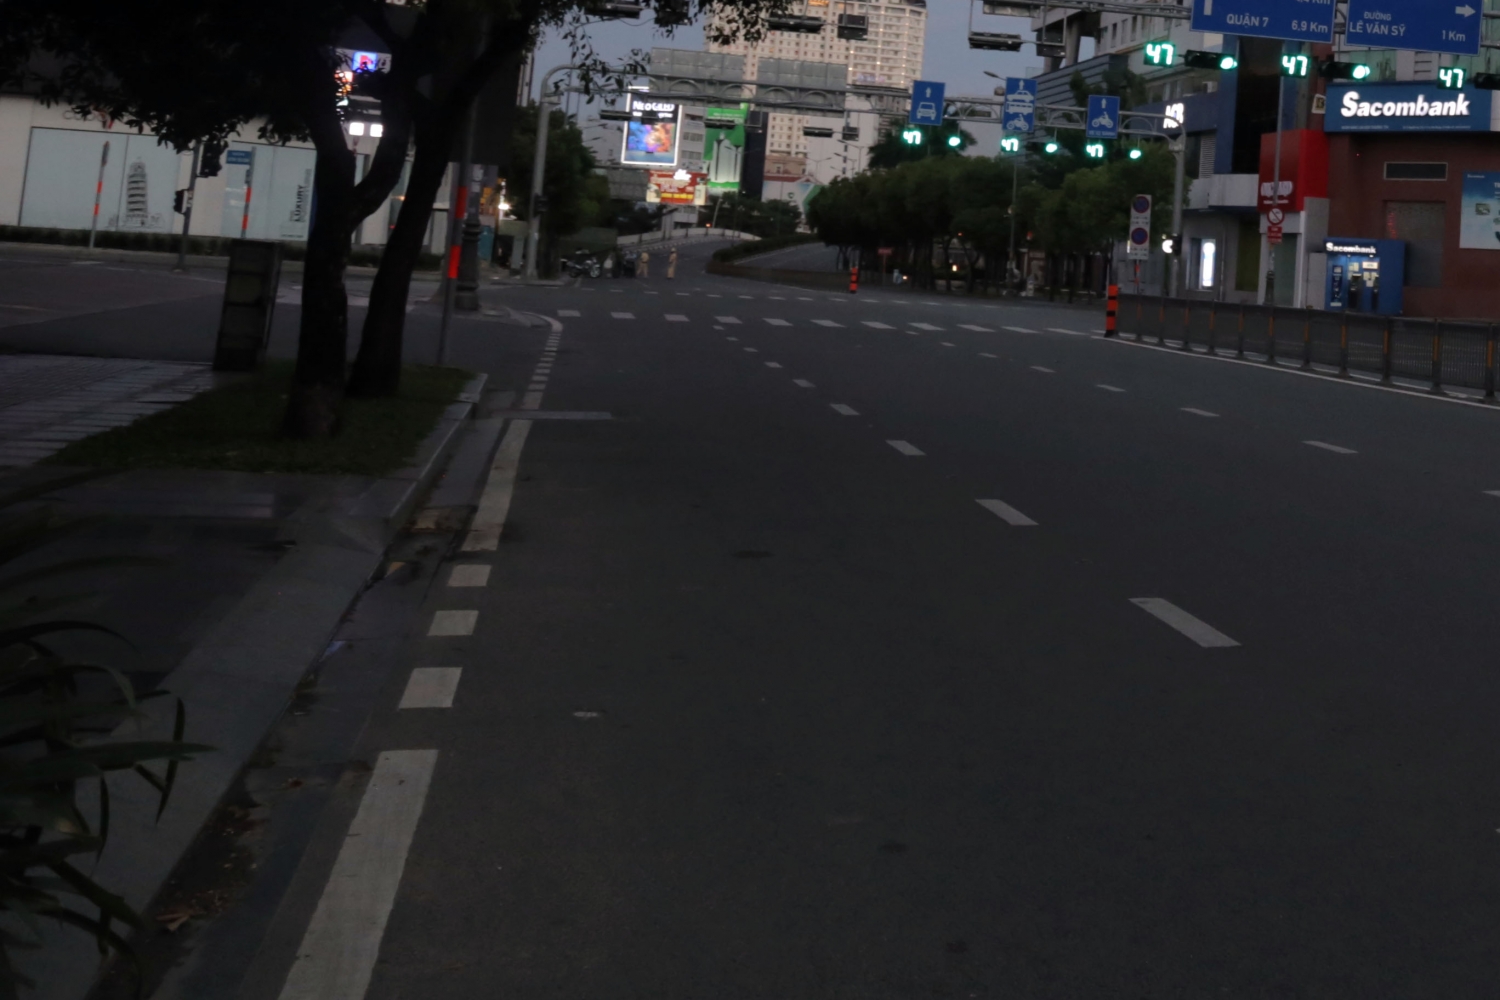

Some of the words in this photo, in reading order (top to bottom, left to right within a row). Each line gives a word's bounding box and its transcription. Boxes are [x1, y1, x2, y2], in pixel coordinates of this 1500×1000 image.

[1226, 12, 1260, 28] QUẬN
[1262, 17, 1269, 28] 7
[1291, 20, 1307, 31] 6.9
[1310, 22, 1328, 33] Km
[1349, 20, 1363, 33] LÊ
[1365, 21, 1389, 35] VĂN
[1449, 31, 1466, 42] Km
[1146, 43, 1175, 65] 47
[1281, 55, 1308, 76] 47
[1439, 68, 1464, 89] 47
[1340, 90, 1471, 118] Sacombank
[902, 130, 922, 145] 47
[1000, 137, 1020, 152] 47
[1086, 144, 1104, 158] 47
[1325, 241, 1377, 254] Sacombank
